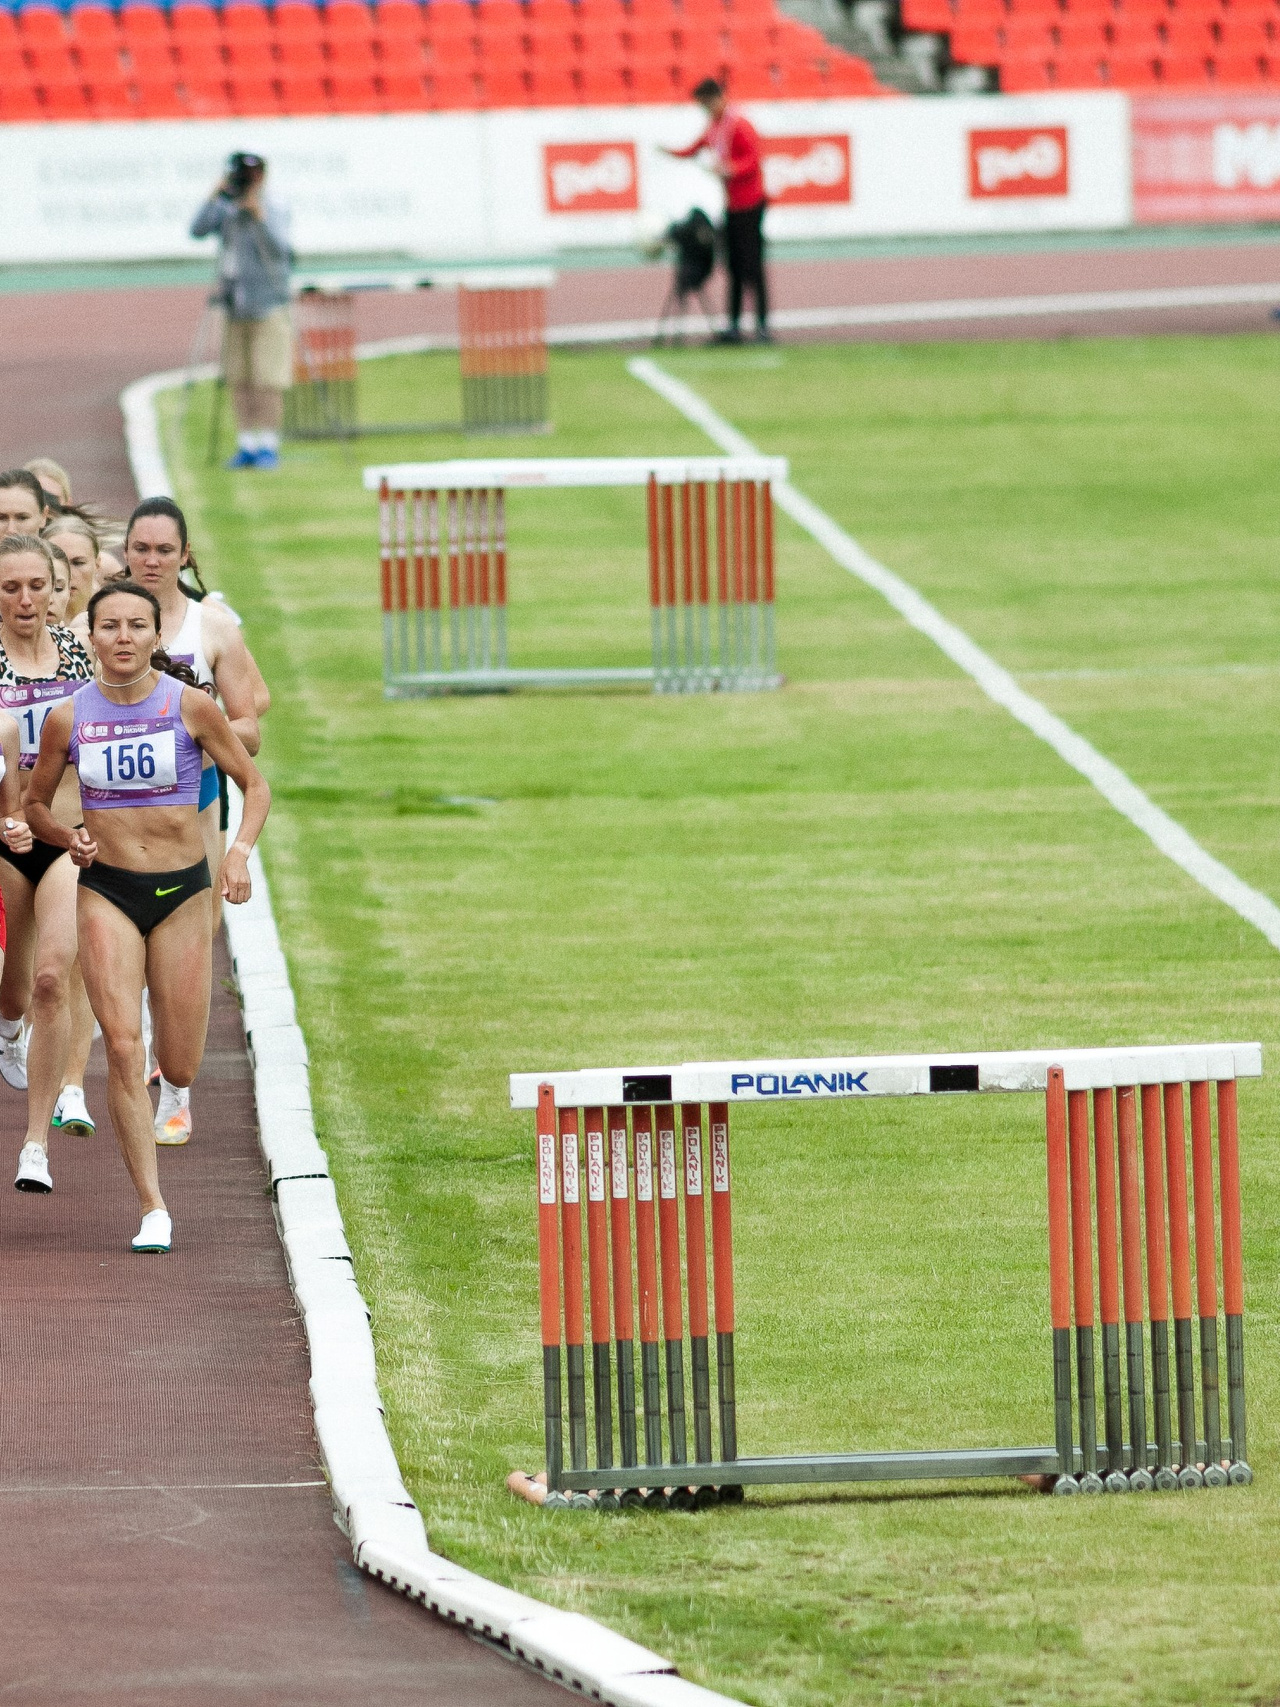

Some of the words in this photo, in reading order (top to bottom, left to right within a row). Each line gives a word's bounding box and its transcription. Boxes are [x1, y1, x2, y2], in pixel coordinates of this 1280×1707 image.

[102, 742, 156, 782] 156
[731, 1070, 870, 1096] POLANIK
[541, 1137, 553, 1195] POLANIK
[564, 1136, 576, 1195] POLANIK
[589, 1134, 601, 1193] POLANIK
[687, 1128, 699, 1187] POLANIK
[713, 1125, 726, 1184] POLANIK
